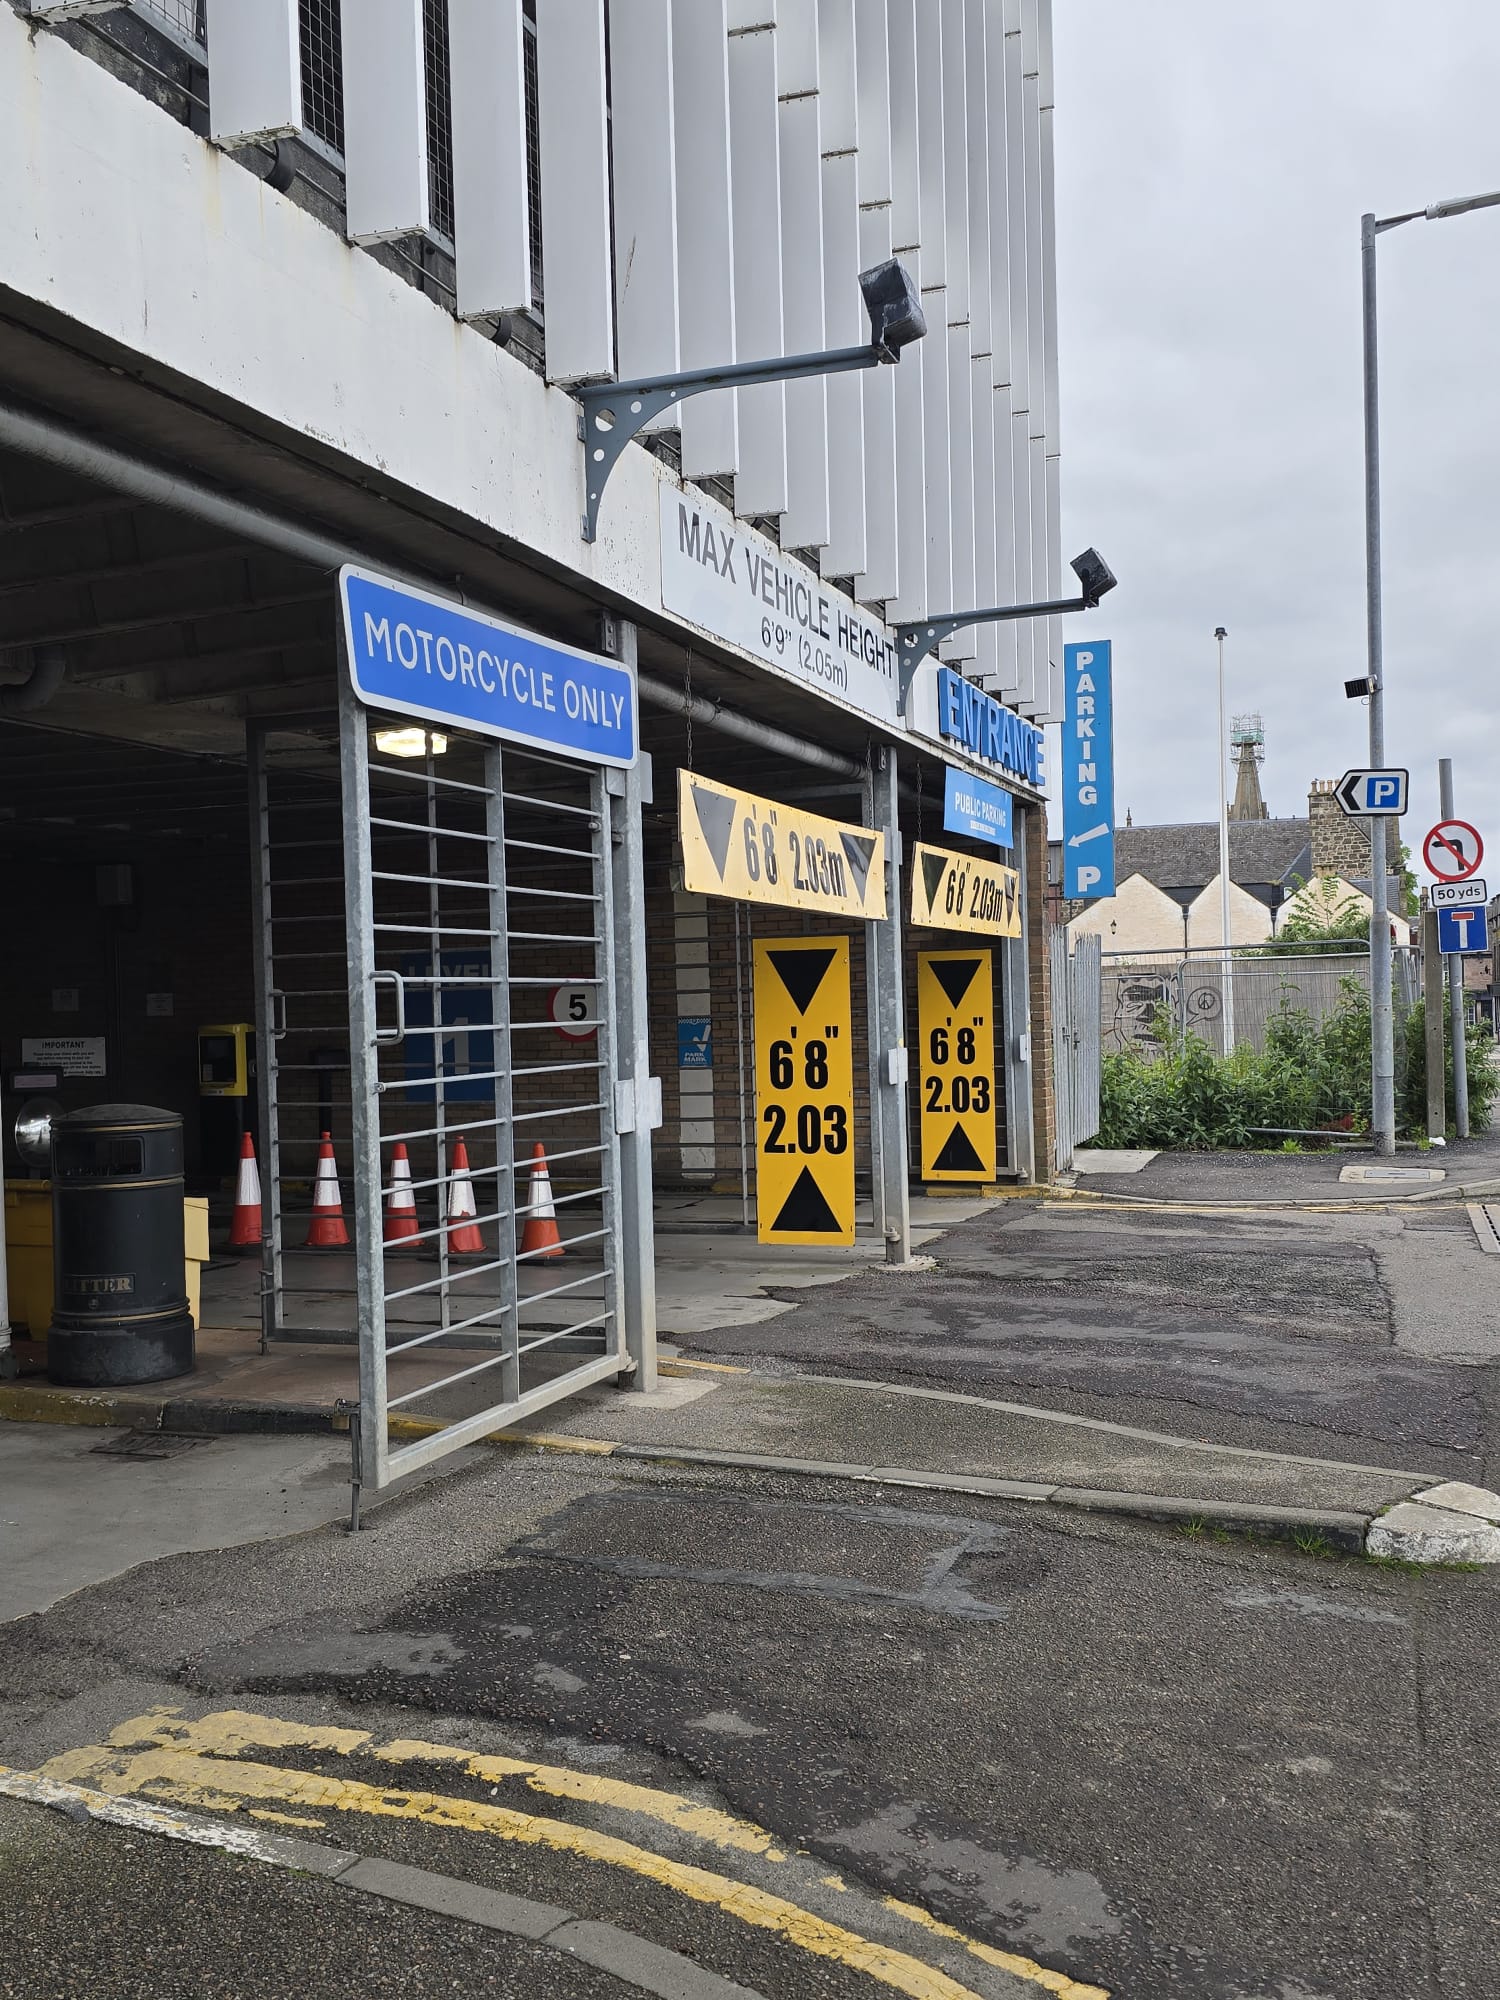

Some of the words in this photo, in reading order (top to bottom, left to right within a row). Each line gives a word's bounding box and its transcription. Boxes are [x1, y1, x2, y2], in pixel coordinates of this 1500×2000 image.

[678, 502, 736, 584] MAX
[745, 547, 830, 641] VEHICLE
[838, 609, 894, 679] HEIGHT
[364, 612, 556, 712] MOTORCYCLE
[563, 679, 624, 730] ONLY
[798, 634, 848, 692] (2.05m)
[937, 667, 1046, 787] ENTRANCE
[1076, 651, 1098, 806] PARKING
[954, 791, 980, 818] PUBLIC
[981, 801, 1006, 828] PARKING
[1374, 781, 1395, 806] P
[789, 830, 848, 898] 2.03m
[1077, 866, 1101, 893] P
[970, 876, 1003, 923] 2.03m
[1437, 888, 1455, 900] 50
[1458, 886, 1481, 900] yds
[569, 994, 587, 1021] 5
[42, 1041, 85, 1049] IMPORTANT
[925, 1075, 991, 1113] 2.03
[763, 1104, 848, 1155] 2.03
